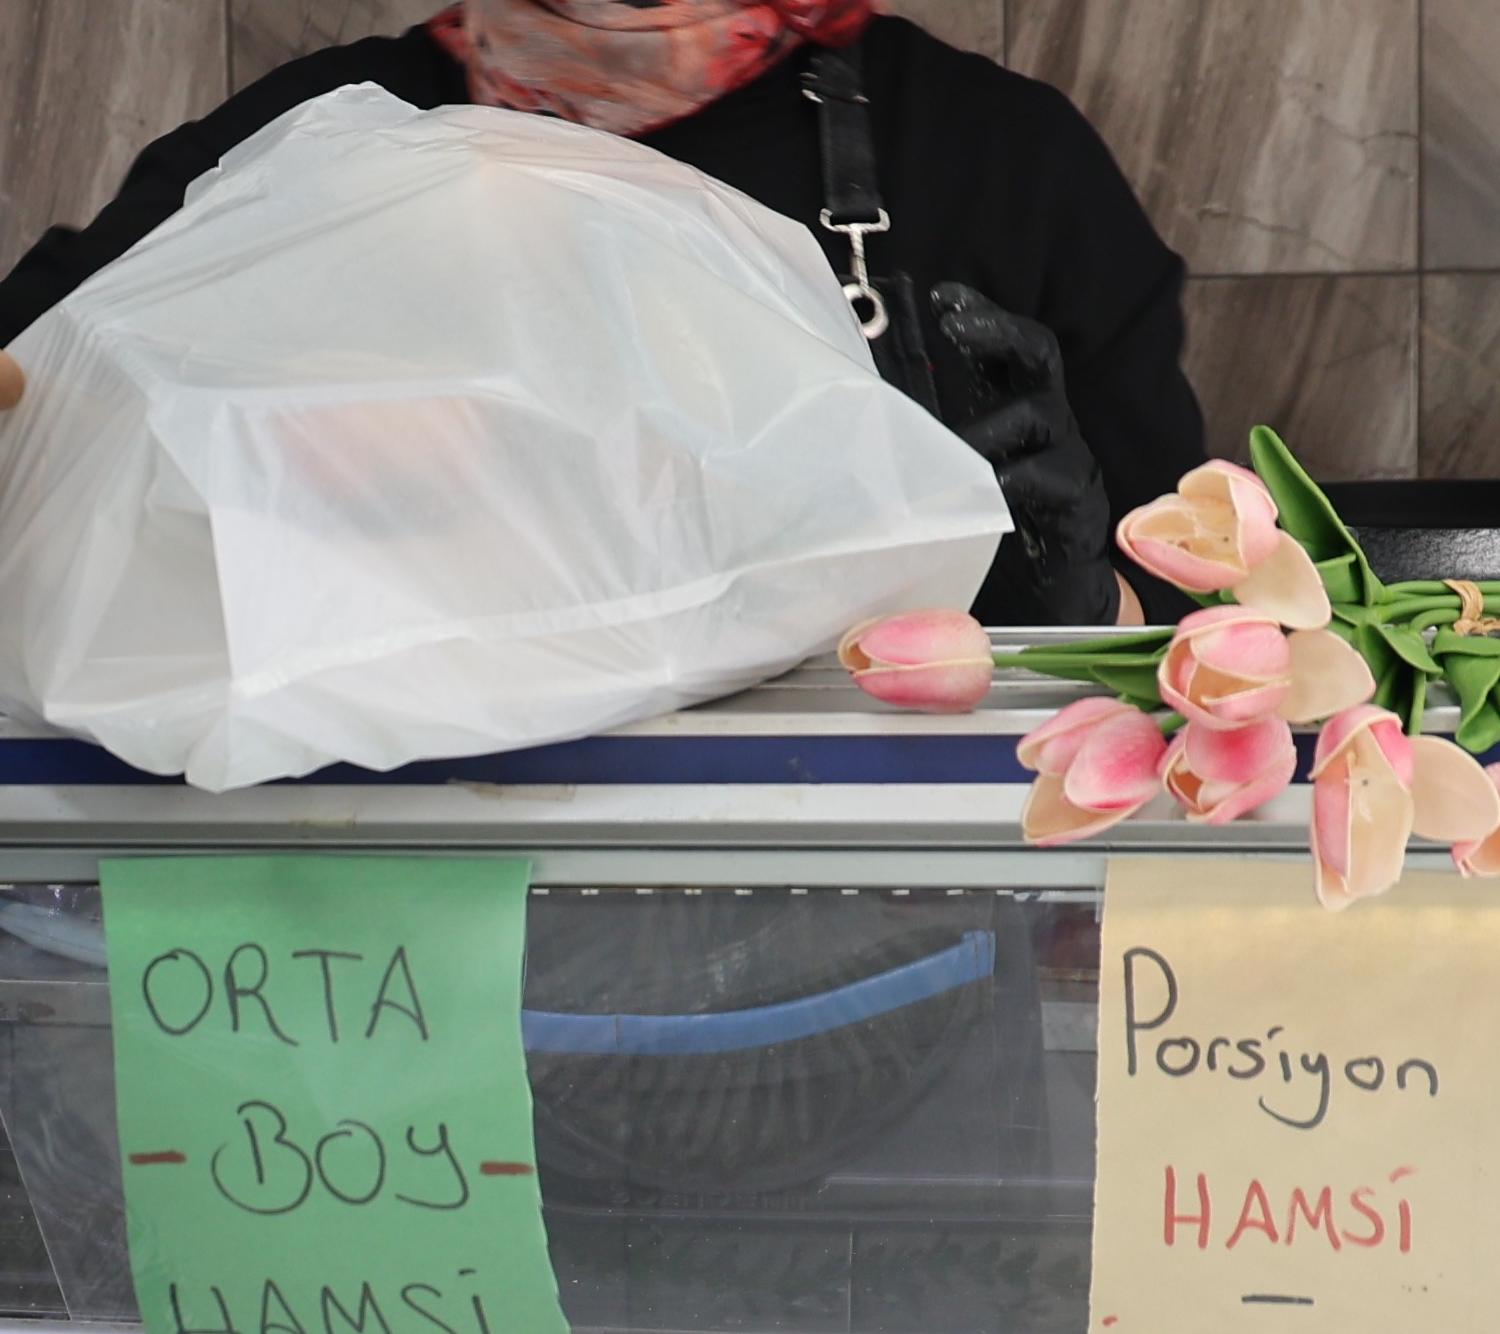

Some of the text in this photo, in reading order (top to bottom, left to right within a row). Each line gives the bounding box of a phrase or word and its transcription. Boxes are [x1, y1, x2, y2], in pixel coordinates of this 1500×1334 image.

[140, 942, 429, 1046] ORTA
[1122, 946, 1439, 1129] Porsiyon
[1163, 1164, 1418, 1254] HAMSİ
